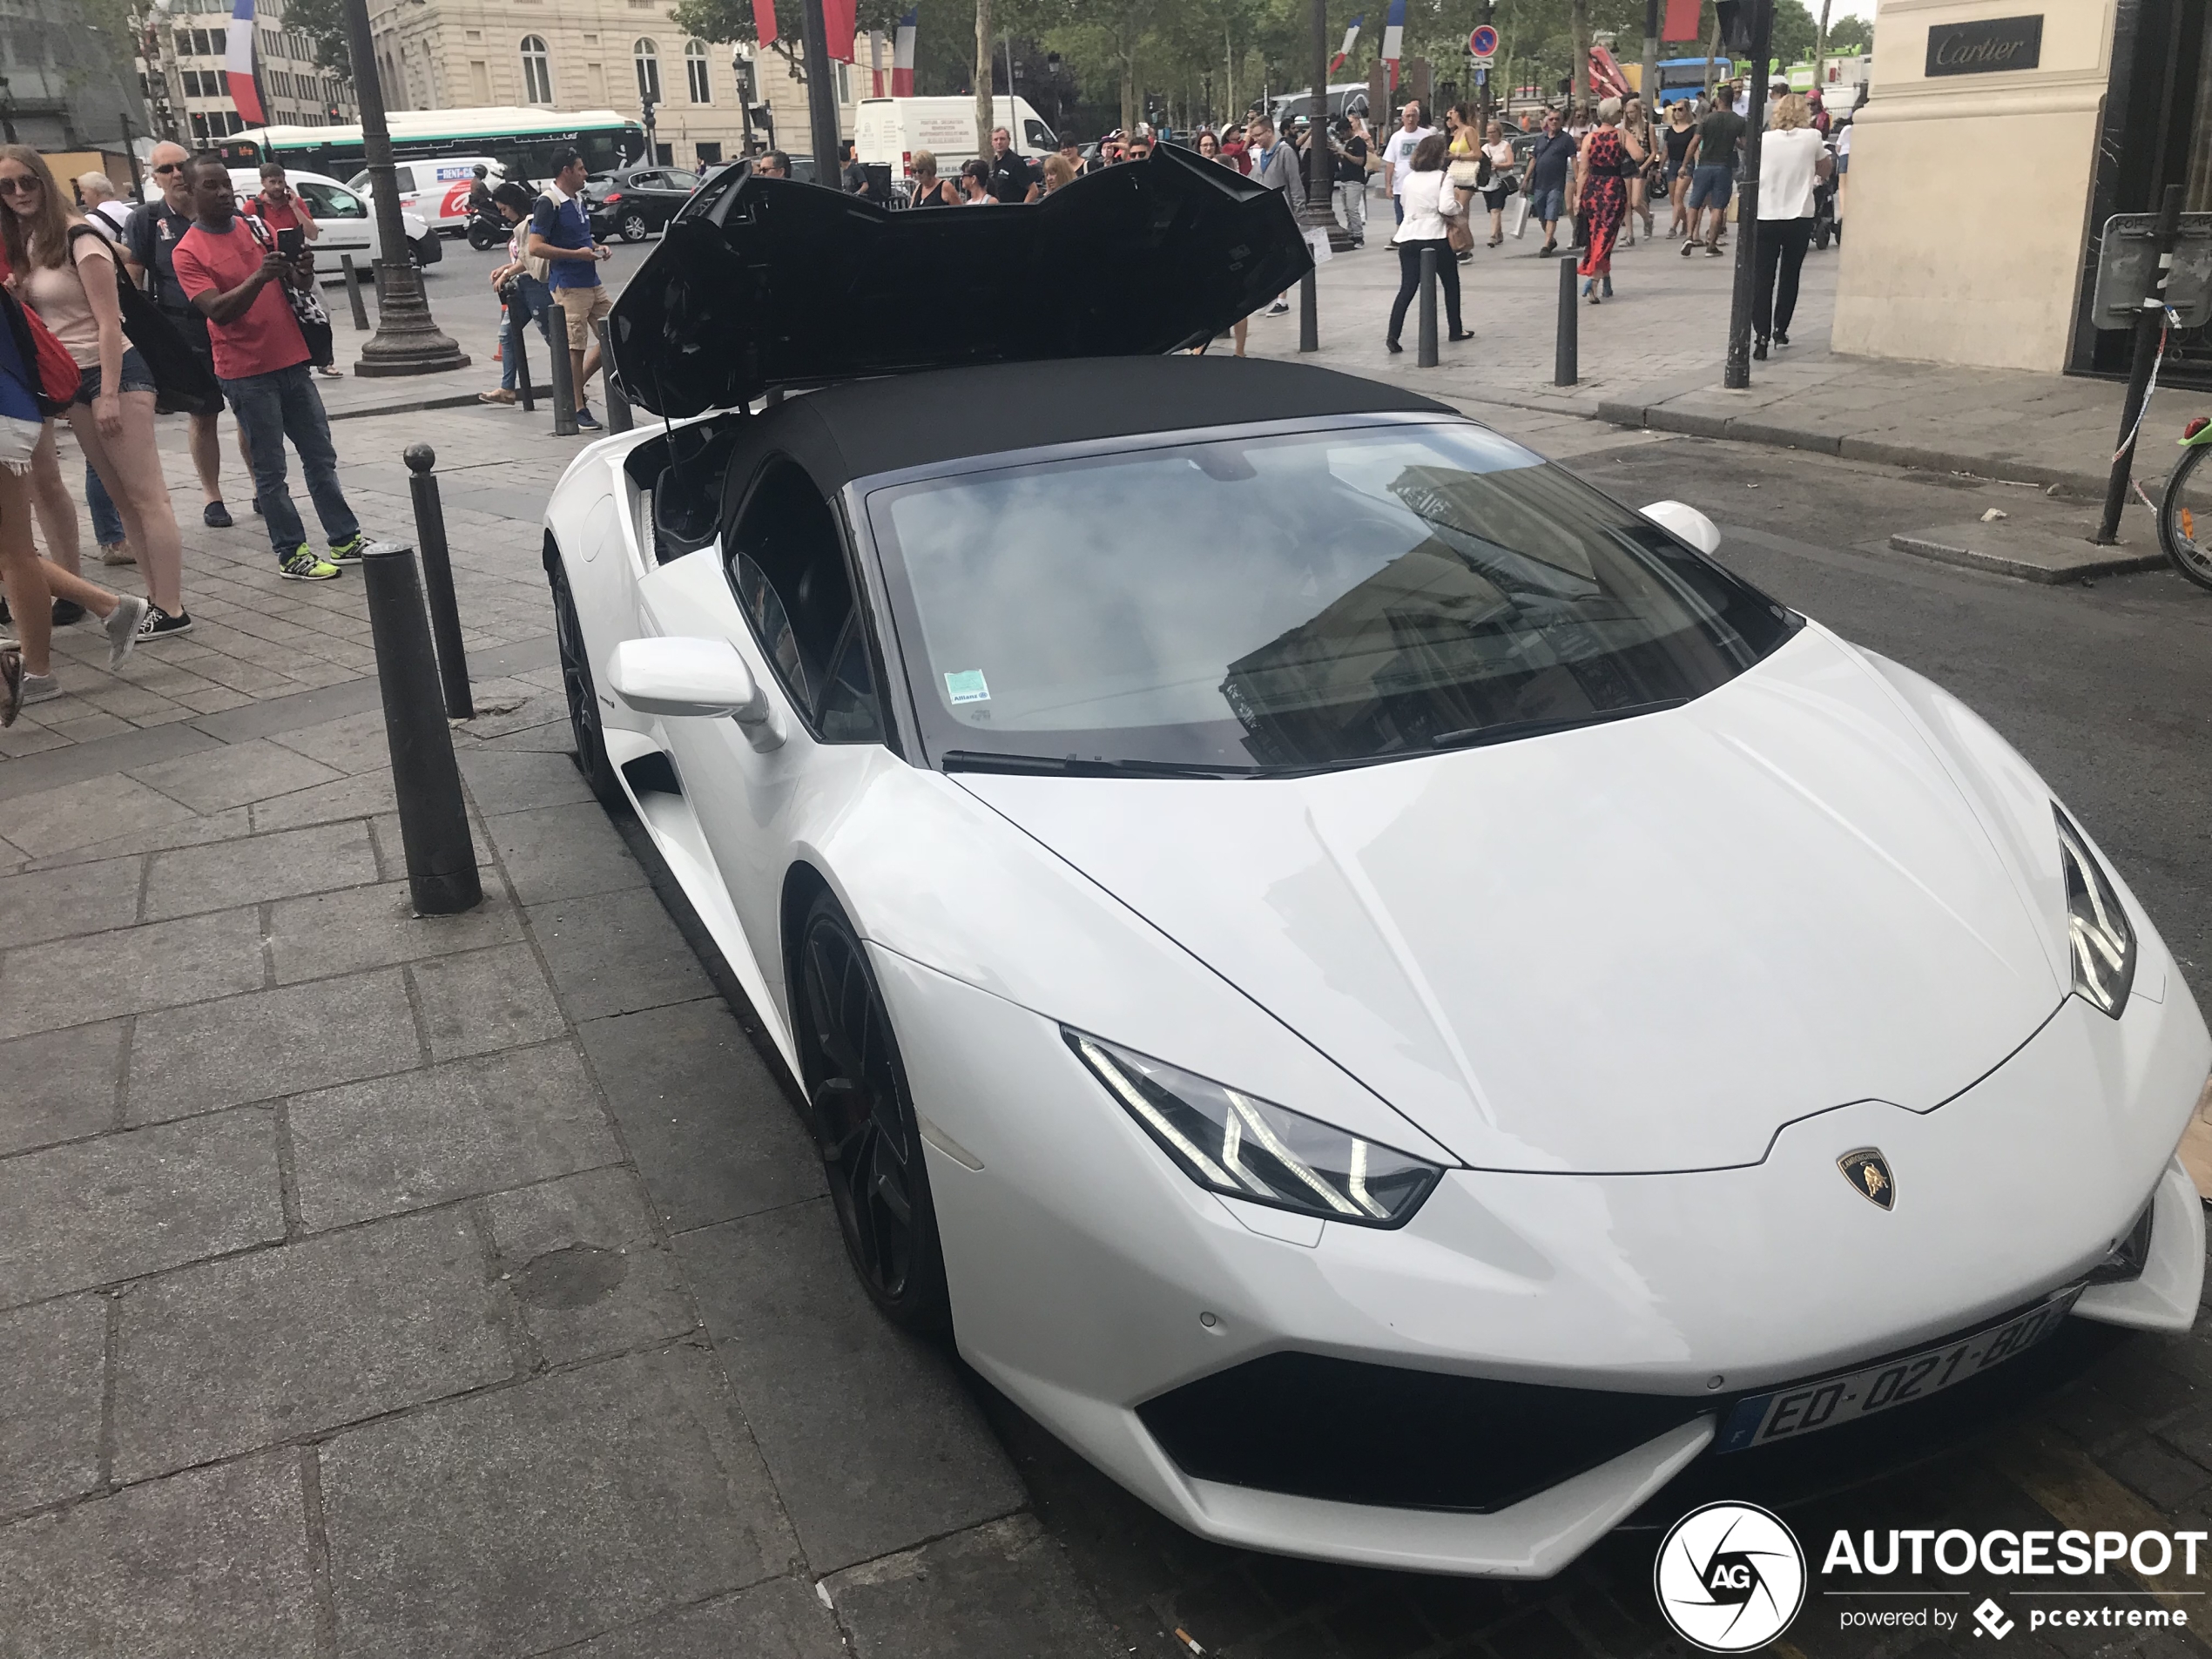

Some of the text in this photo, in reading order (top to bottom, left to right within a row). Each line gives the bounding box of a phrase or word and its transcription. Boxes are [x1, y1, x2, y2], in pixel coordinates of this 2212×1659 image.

[1936, 30, 2025, 65] Cartier
[442, 168, 460, 179] RENT
[1730, 1429, 1745, 1444] F
